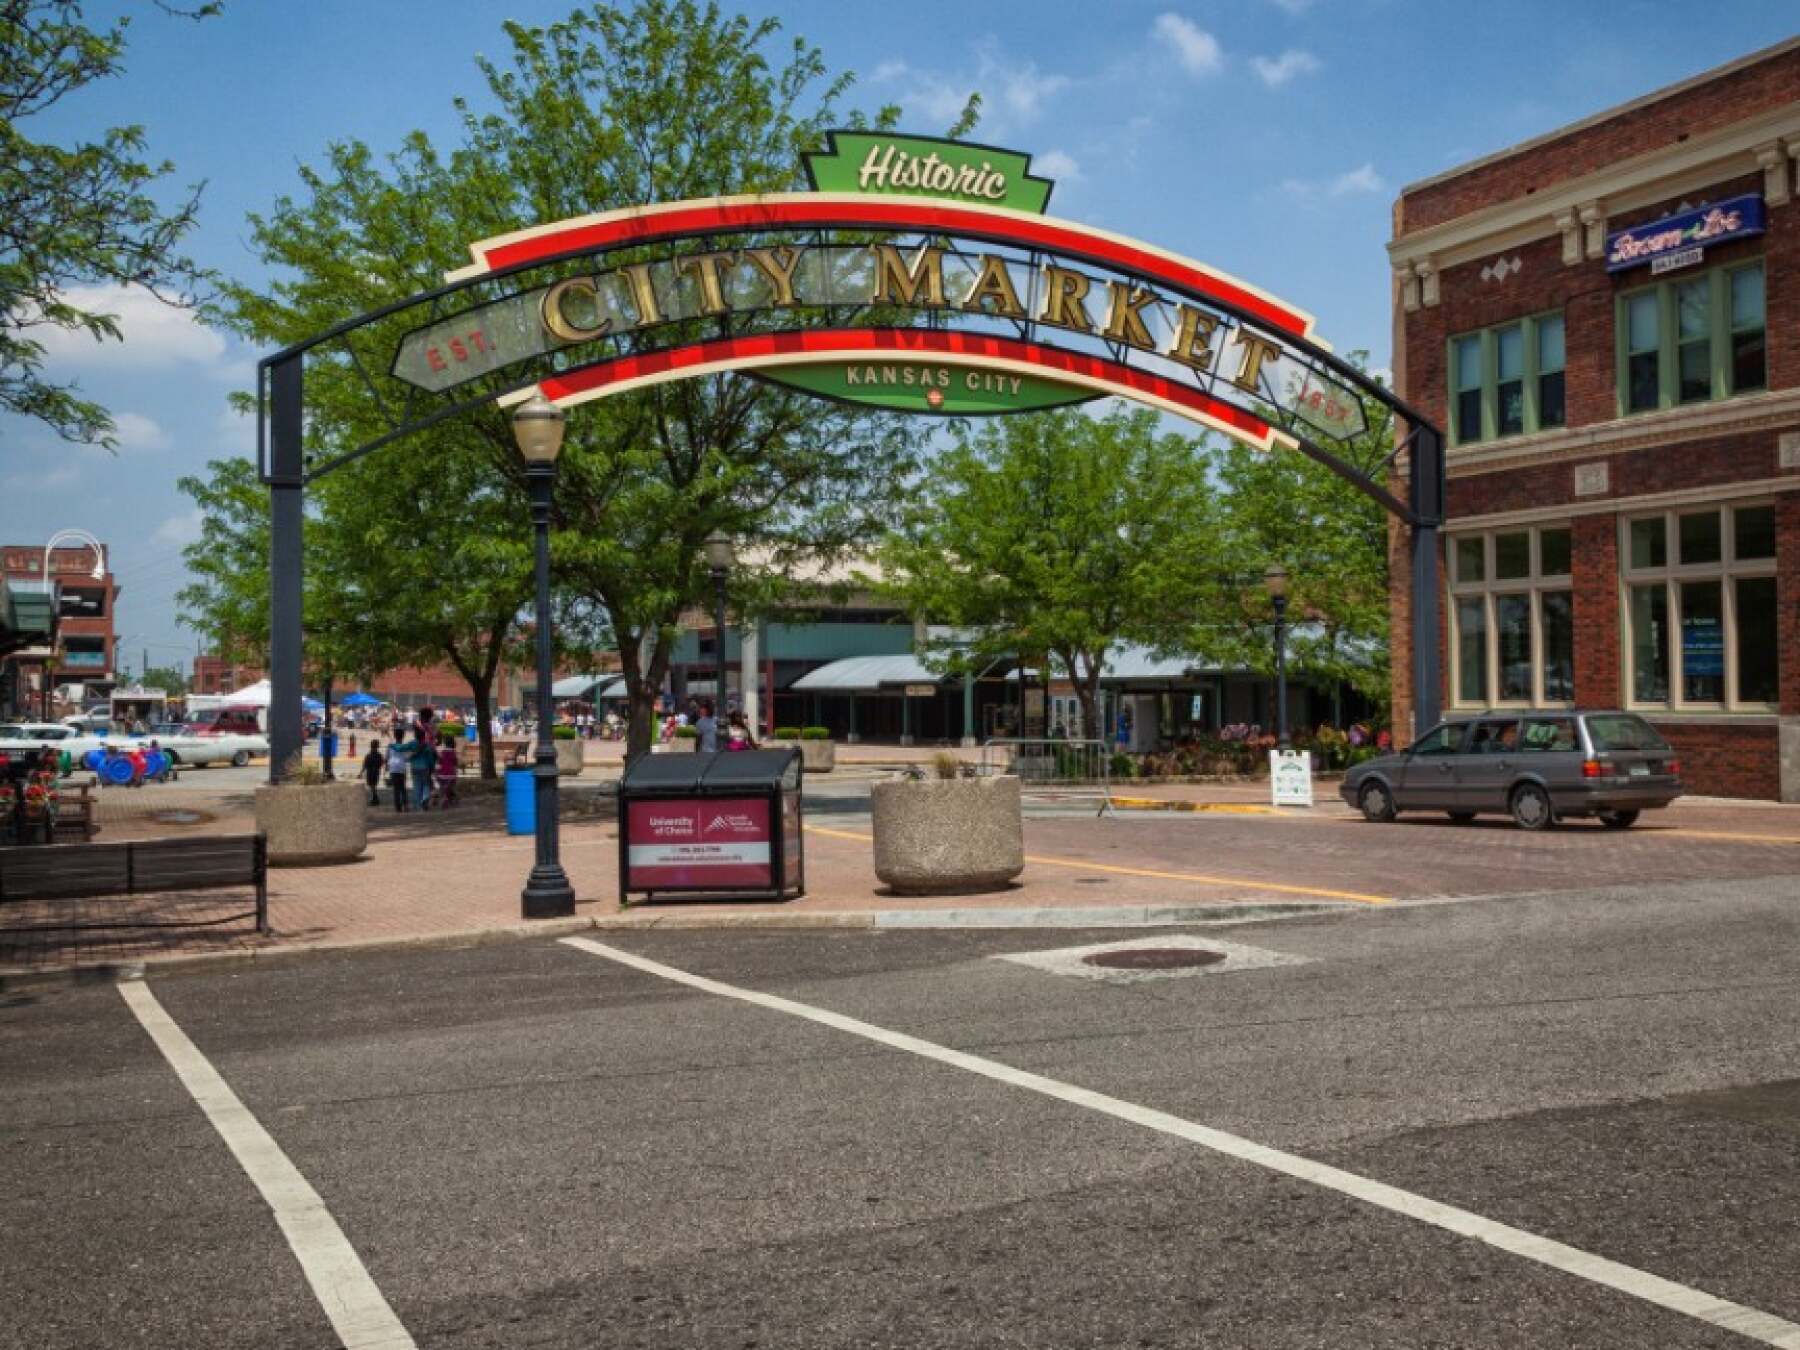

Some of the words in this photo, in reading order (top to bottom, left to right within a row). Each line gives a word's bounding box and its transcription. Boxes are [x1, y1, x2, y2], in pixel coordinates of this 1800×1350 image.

[859, 145, 1005, 198] Historic
[540, 247, 801, 341] CITY
[872, 246, 1280, 392] MARKET
[426, 331, 496, 374] EST.
[848, 366, 950, 386] KANSAS
[966, 373, 1021, 394] CITY
